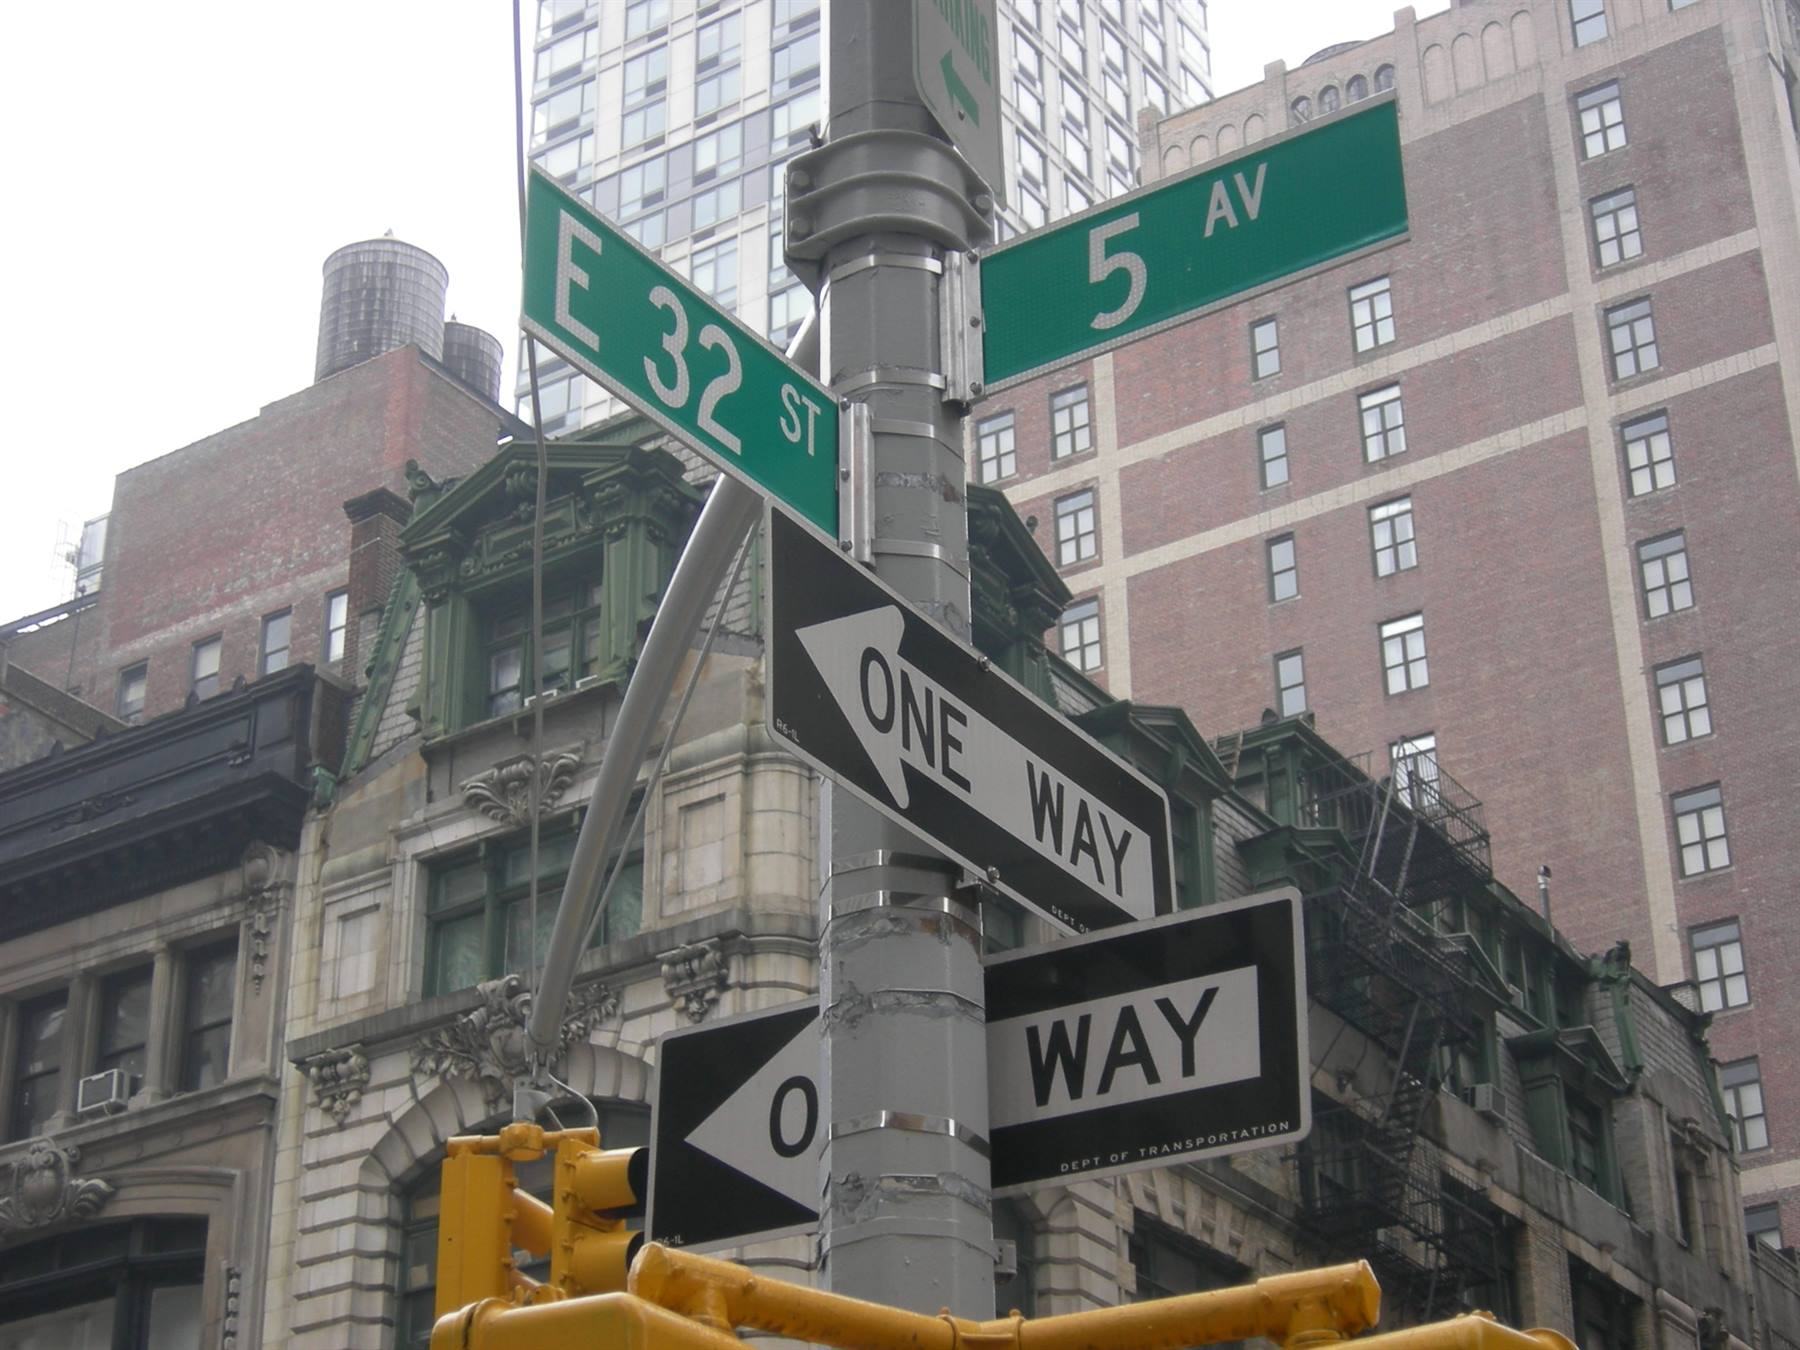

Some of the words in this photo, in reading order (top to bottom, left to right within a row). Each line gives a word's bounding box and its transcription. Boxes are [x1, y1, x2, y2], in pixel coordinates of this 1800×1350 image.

[1088, 211, 1148, 330] 5
[1204, 162, 1268, 238] AV
[555, 208, 602, 352] E
[643, 285, 743, 456] 32
[779, 383, 821, 456] ST
[860, 646, 971, 794] ONE
[1026, 760, 1132, 897] WAY
[1051, 904, 1075, 926] DEPT
[1025, 986, 1220, 1108] WAY
[1060, 1158, 1101, 1173] DEPT
[1110, 1151, 1129, 1164] OF
[1139, 1121, 1290, 1157] TRANSPORTATION
